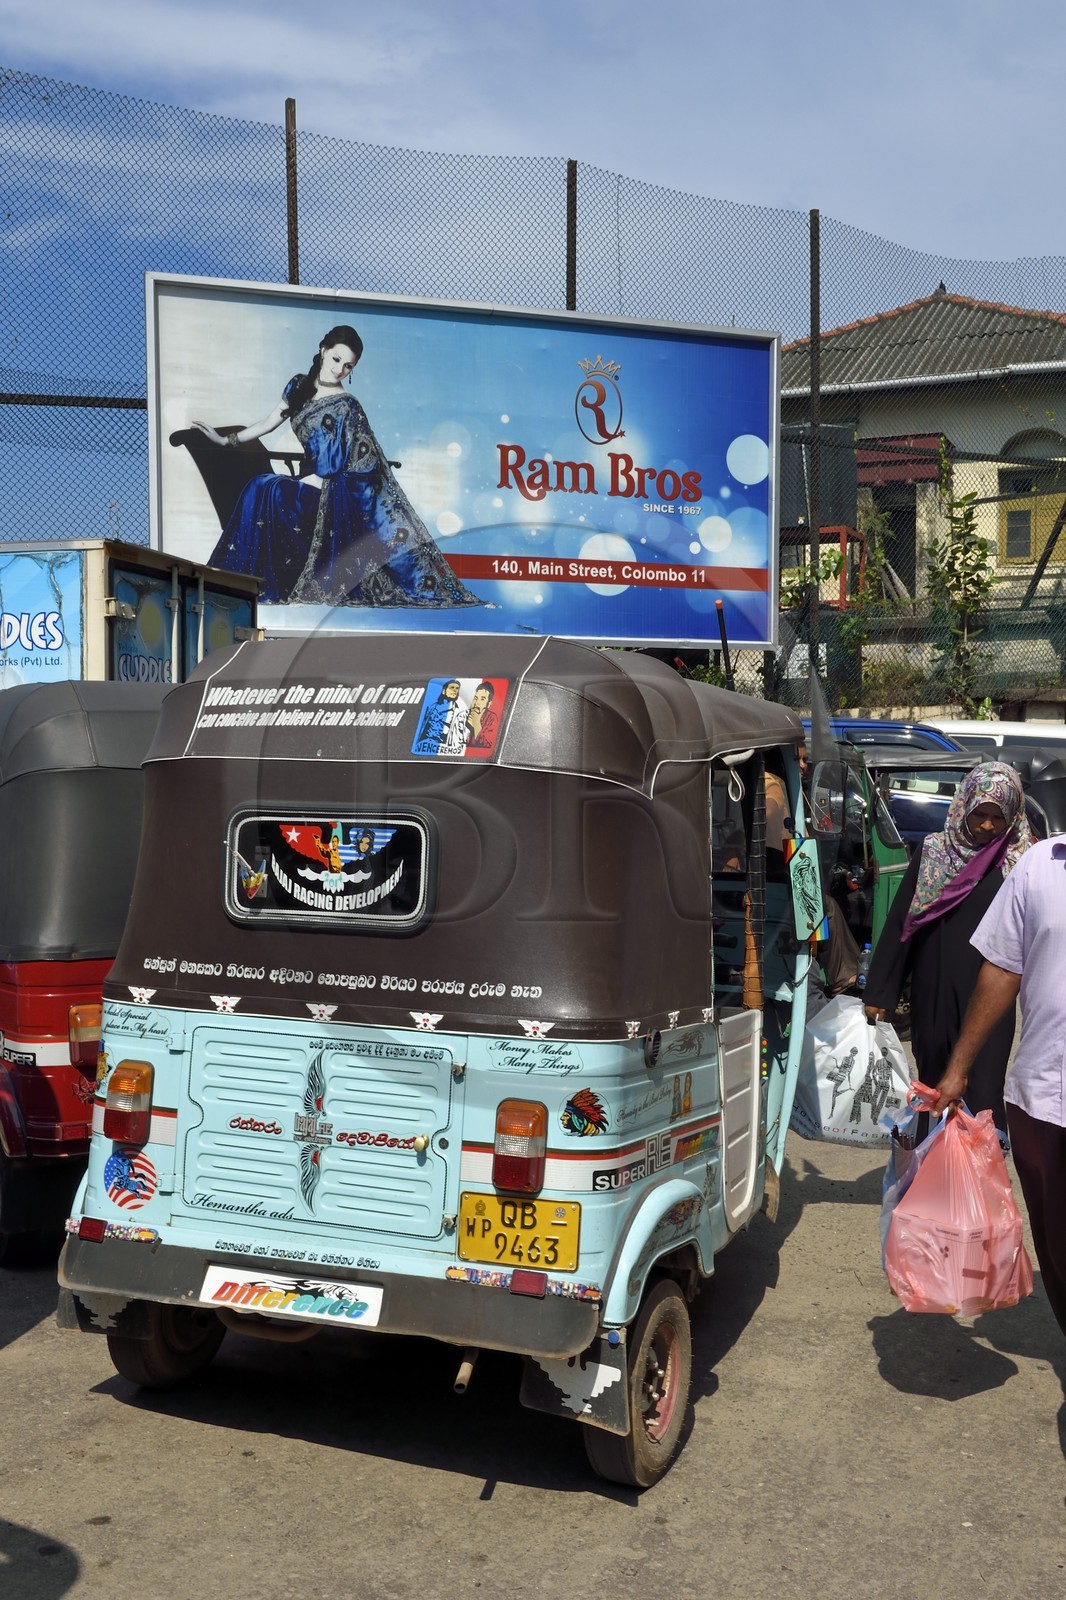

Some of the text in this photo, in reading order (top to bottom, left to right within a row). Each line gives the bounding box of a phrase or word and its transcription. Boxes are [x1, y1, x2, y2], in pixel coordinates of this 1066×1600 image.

[496, 444, 702, 503] Ram Bros
[643, 503, 702, 515] SINCE 1967
[492, 560, 706, 583] 140, Main Street, Colombo 11
[0, 611, 64, 651] DLES
[0, 656, 63, 668] orks (Pvt) Ltd.
[118, 653, 174, 683] CUDDLE
[204, 684, 425, 707] Whatever the mind of man
[197, 708, 405, 728] can conceive and believe it can be achieved
[293, 882, 334, 911] RACING
[334, 858, 404, 911] DEVELOPMENT
[143, 956, 177, 973] සන්සුන්
[179, 960, 223, 976] මනසකට
[226, 963, 265, 980] තිරසාර
[317, 972, 376, 990] නොපසුබට
[421, 979, 465, 995] පරාජය
[469, 982, 506, 998] උරුම
[511, 985, 543, 999] නැත
[121, 1009, 152, 1025] Special
[130, 1022, 148, 1038] My
[148, 1022, 169, 1035] heart
[4, 1050, 33, 1066] SUPER
[489, 1040, 573, 1060] Money Makes
[498, 1057, 581, 1077] Many Things
[594, 1163, 645, 1191] SUPER
[645, 1129, 671, 1176] RE
[190, 1193, 294, 1220] Hemantha ads
[466, 1200, 537, 1238] WP QB
[495, 1233, 559, 1265] 9463
[211, 1281, 370, 1319] Difference
